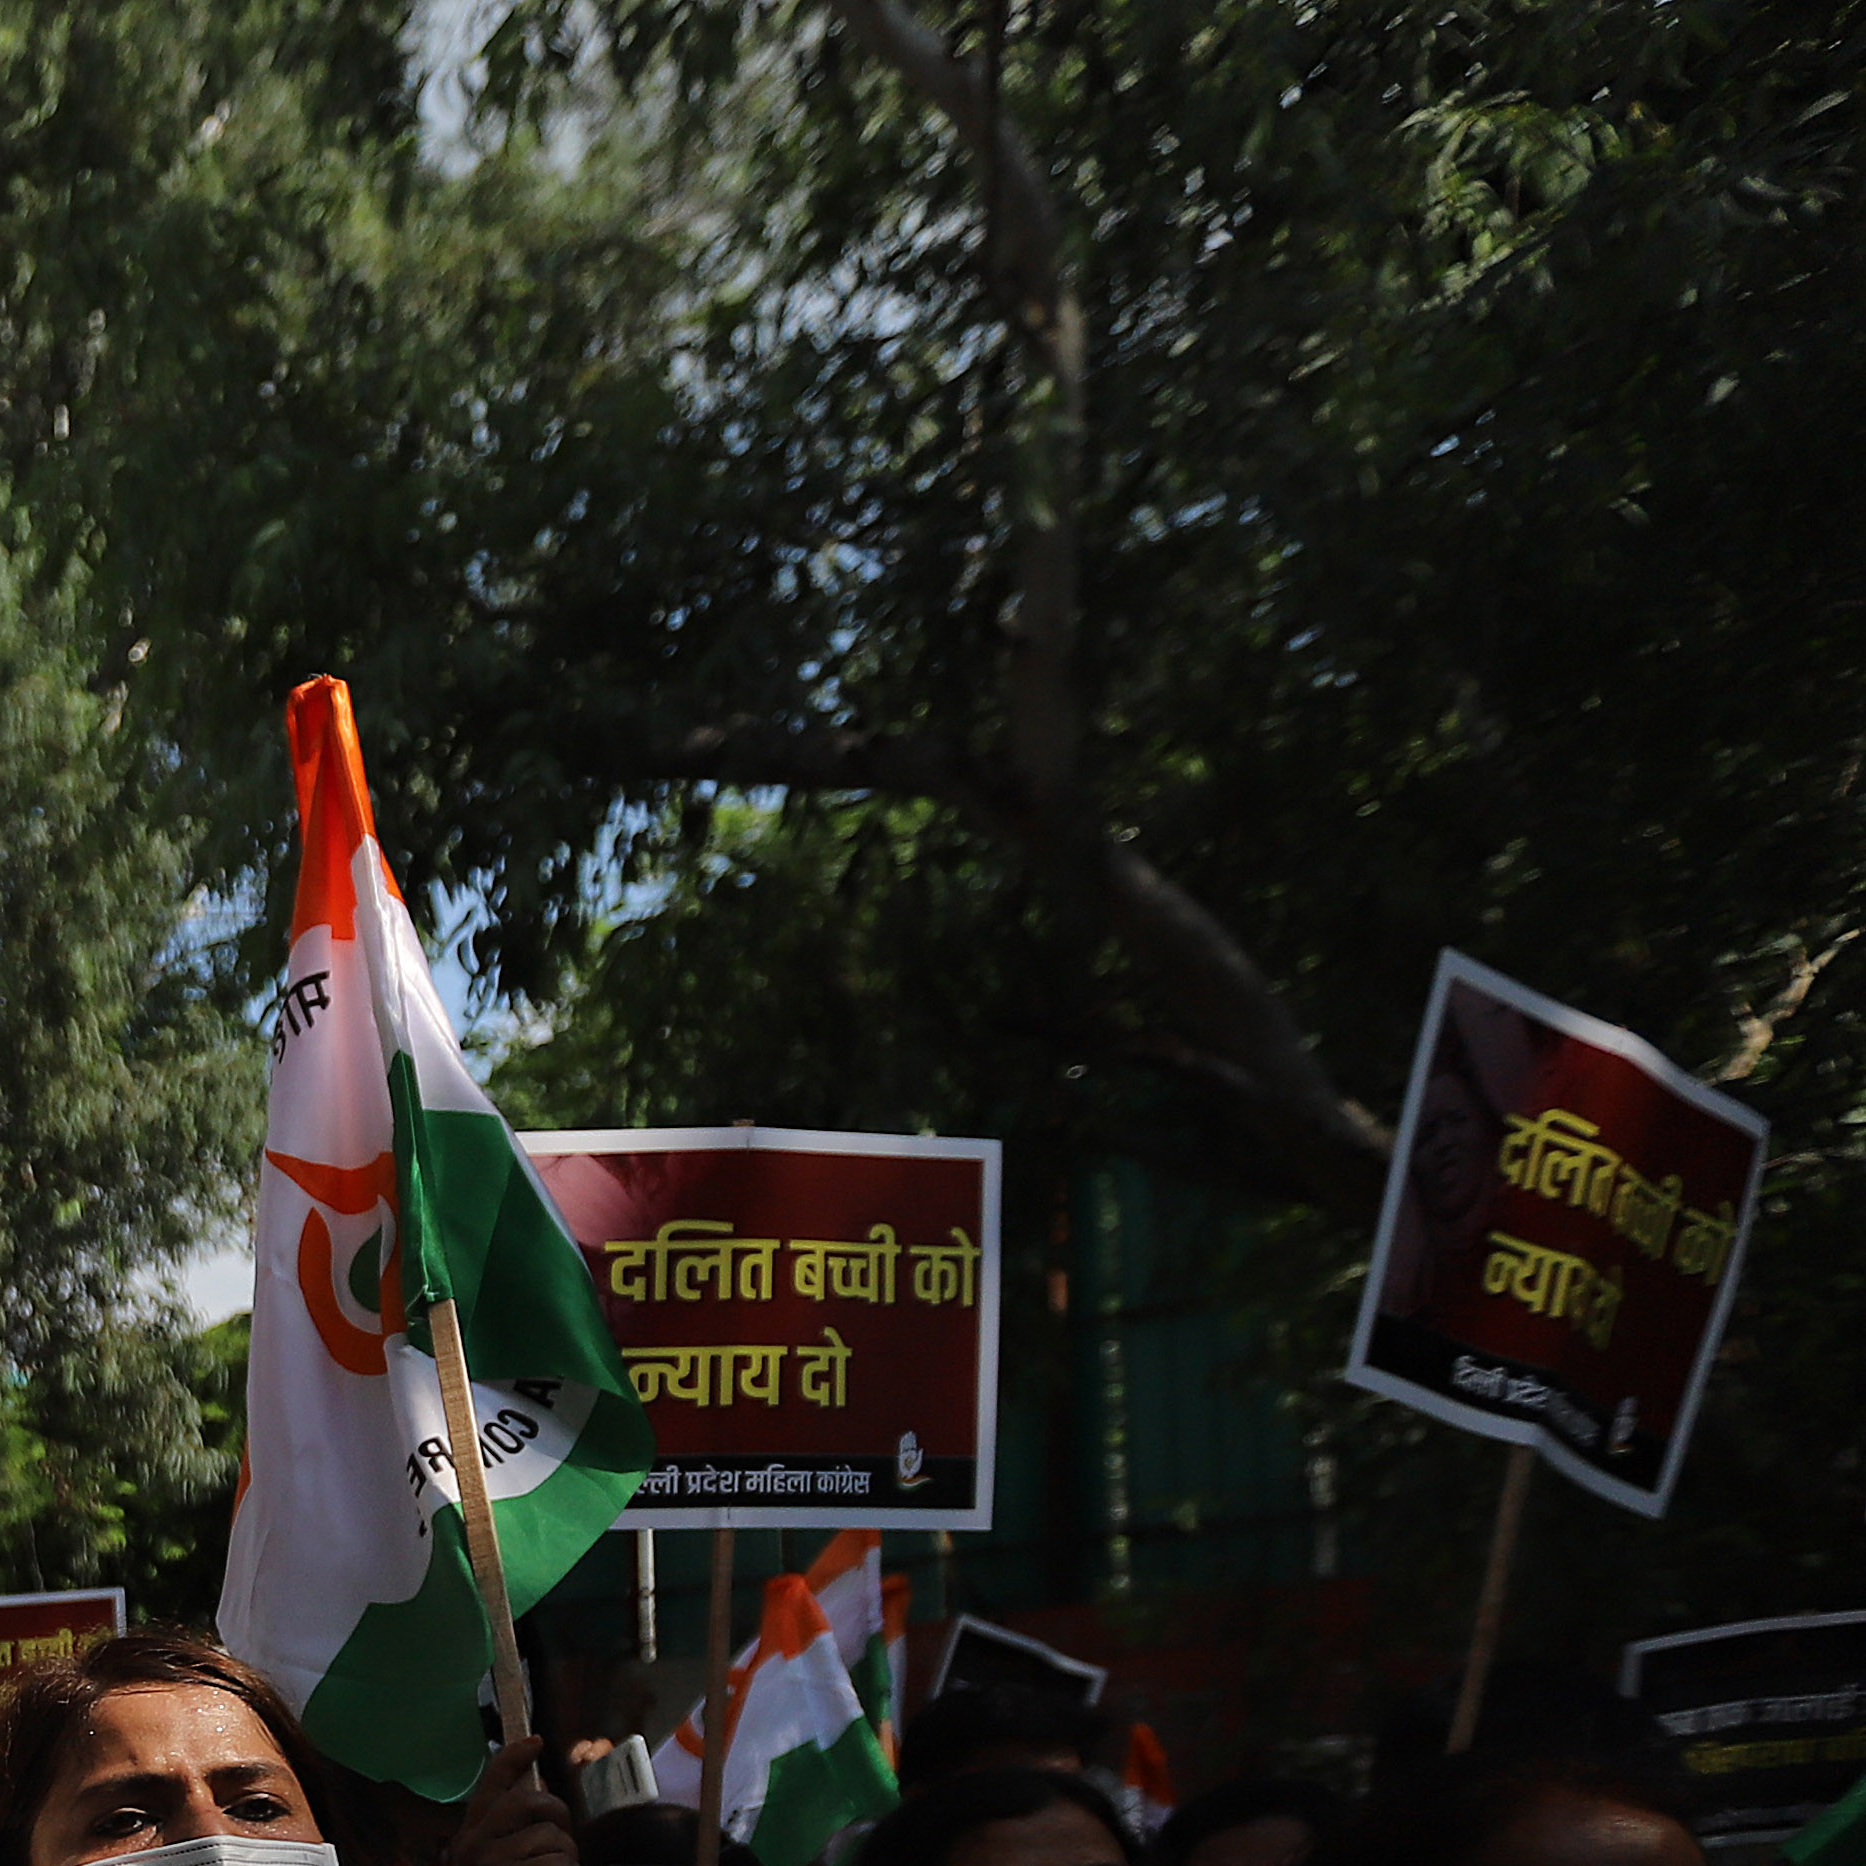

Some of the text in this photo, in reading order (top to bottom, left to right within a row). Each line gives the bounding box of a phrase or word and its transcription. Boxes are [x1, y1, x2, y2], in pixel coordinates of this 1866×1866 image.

[604, 1218, 982, 1307] दलित बच्ची को
[621, 1344, 788, 1407] न्याय
[796, 1326, 852, 1408] दो
[636, 1463, 872, 1496] ल्ली प्रदेश महिला कांग्रेस
